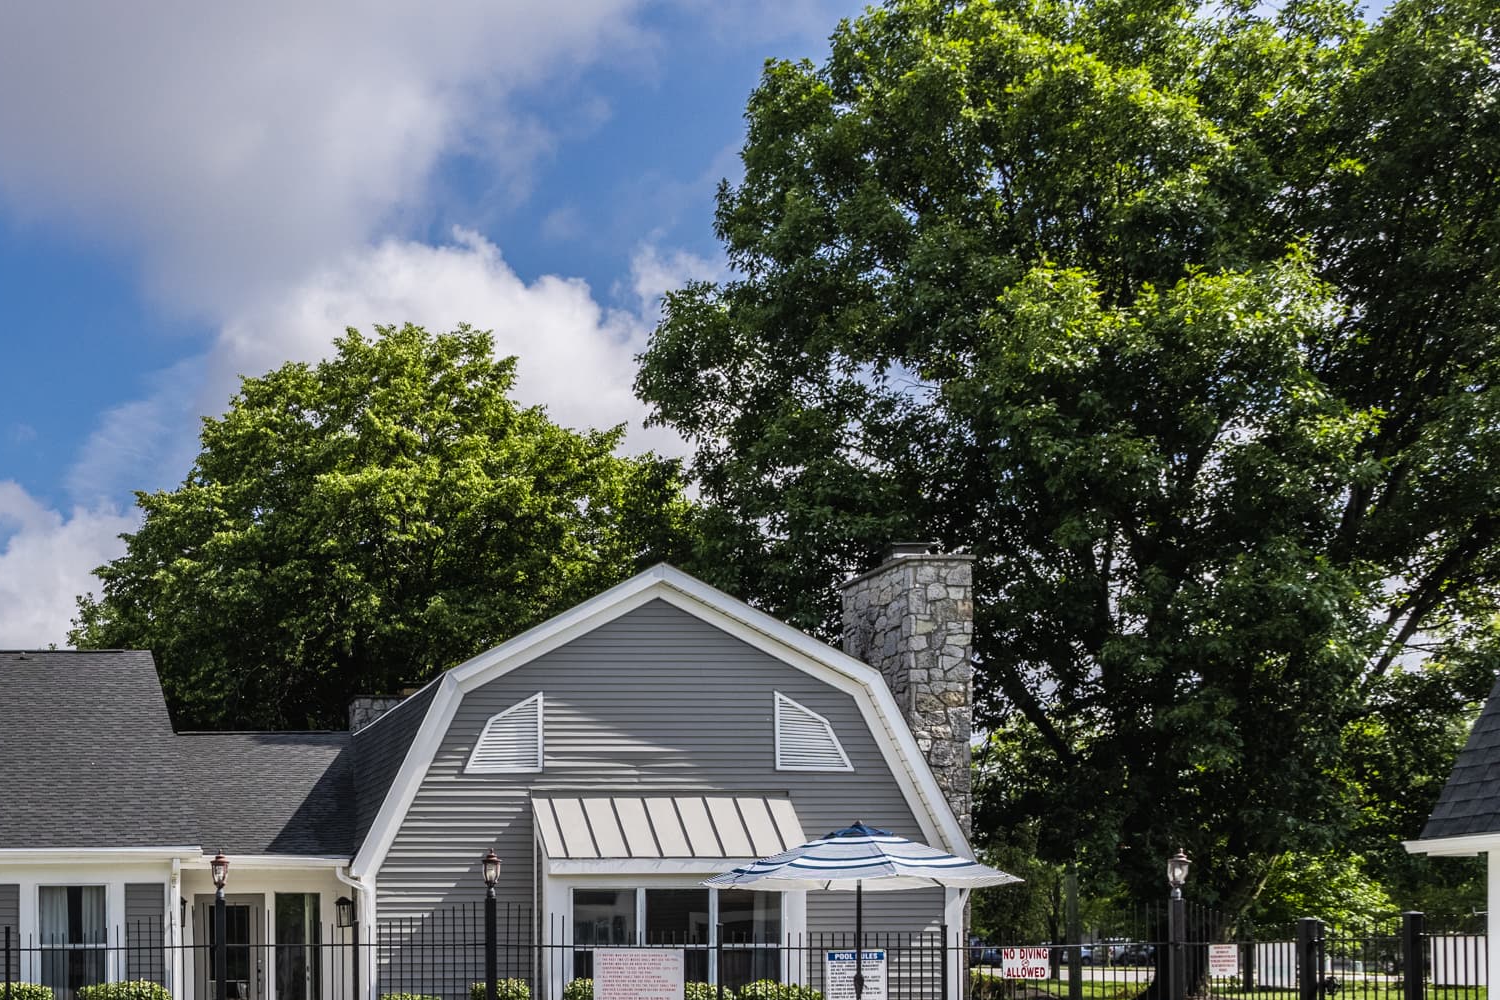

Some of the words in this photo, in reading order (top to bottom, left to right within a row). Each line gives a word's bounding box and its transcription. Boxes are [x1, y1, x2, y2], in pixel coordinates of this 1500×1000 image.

[1003, 947, 1015, 960] NO
[1019, 948, 1048, 960] DIVING
[1006, 967, 1046, 978] ALLOWED
